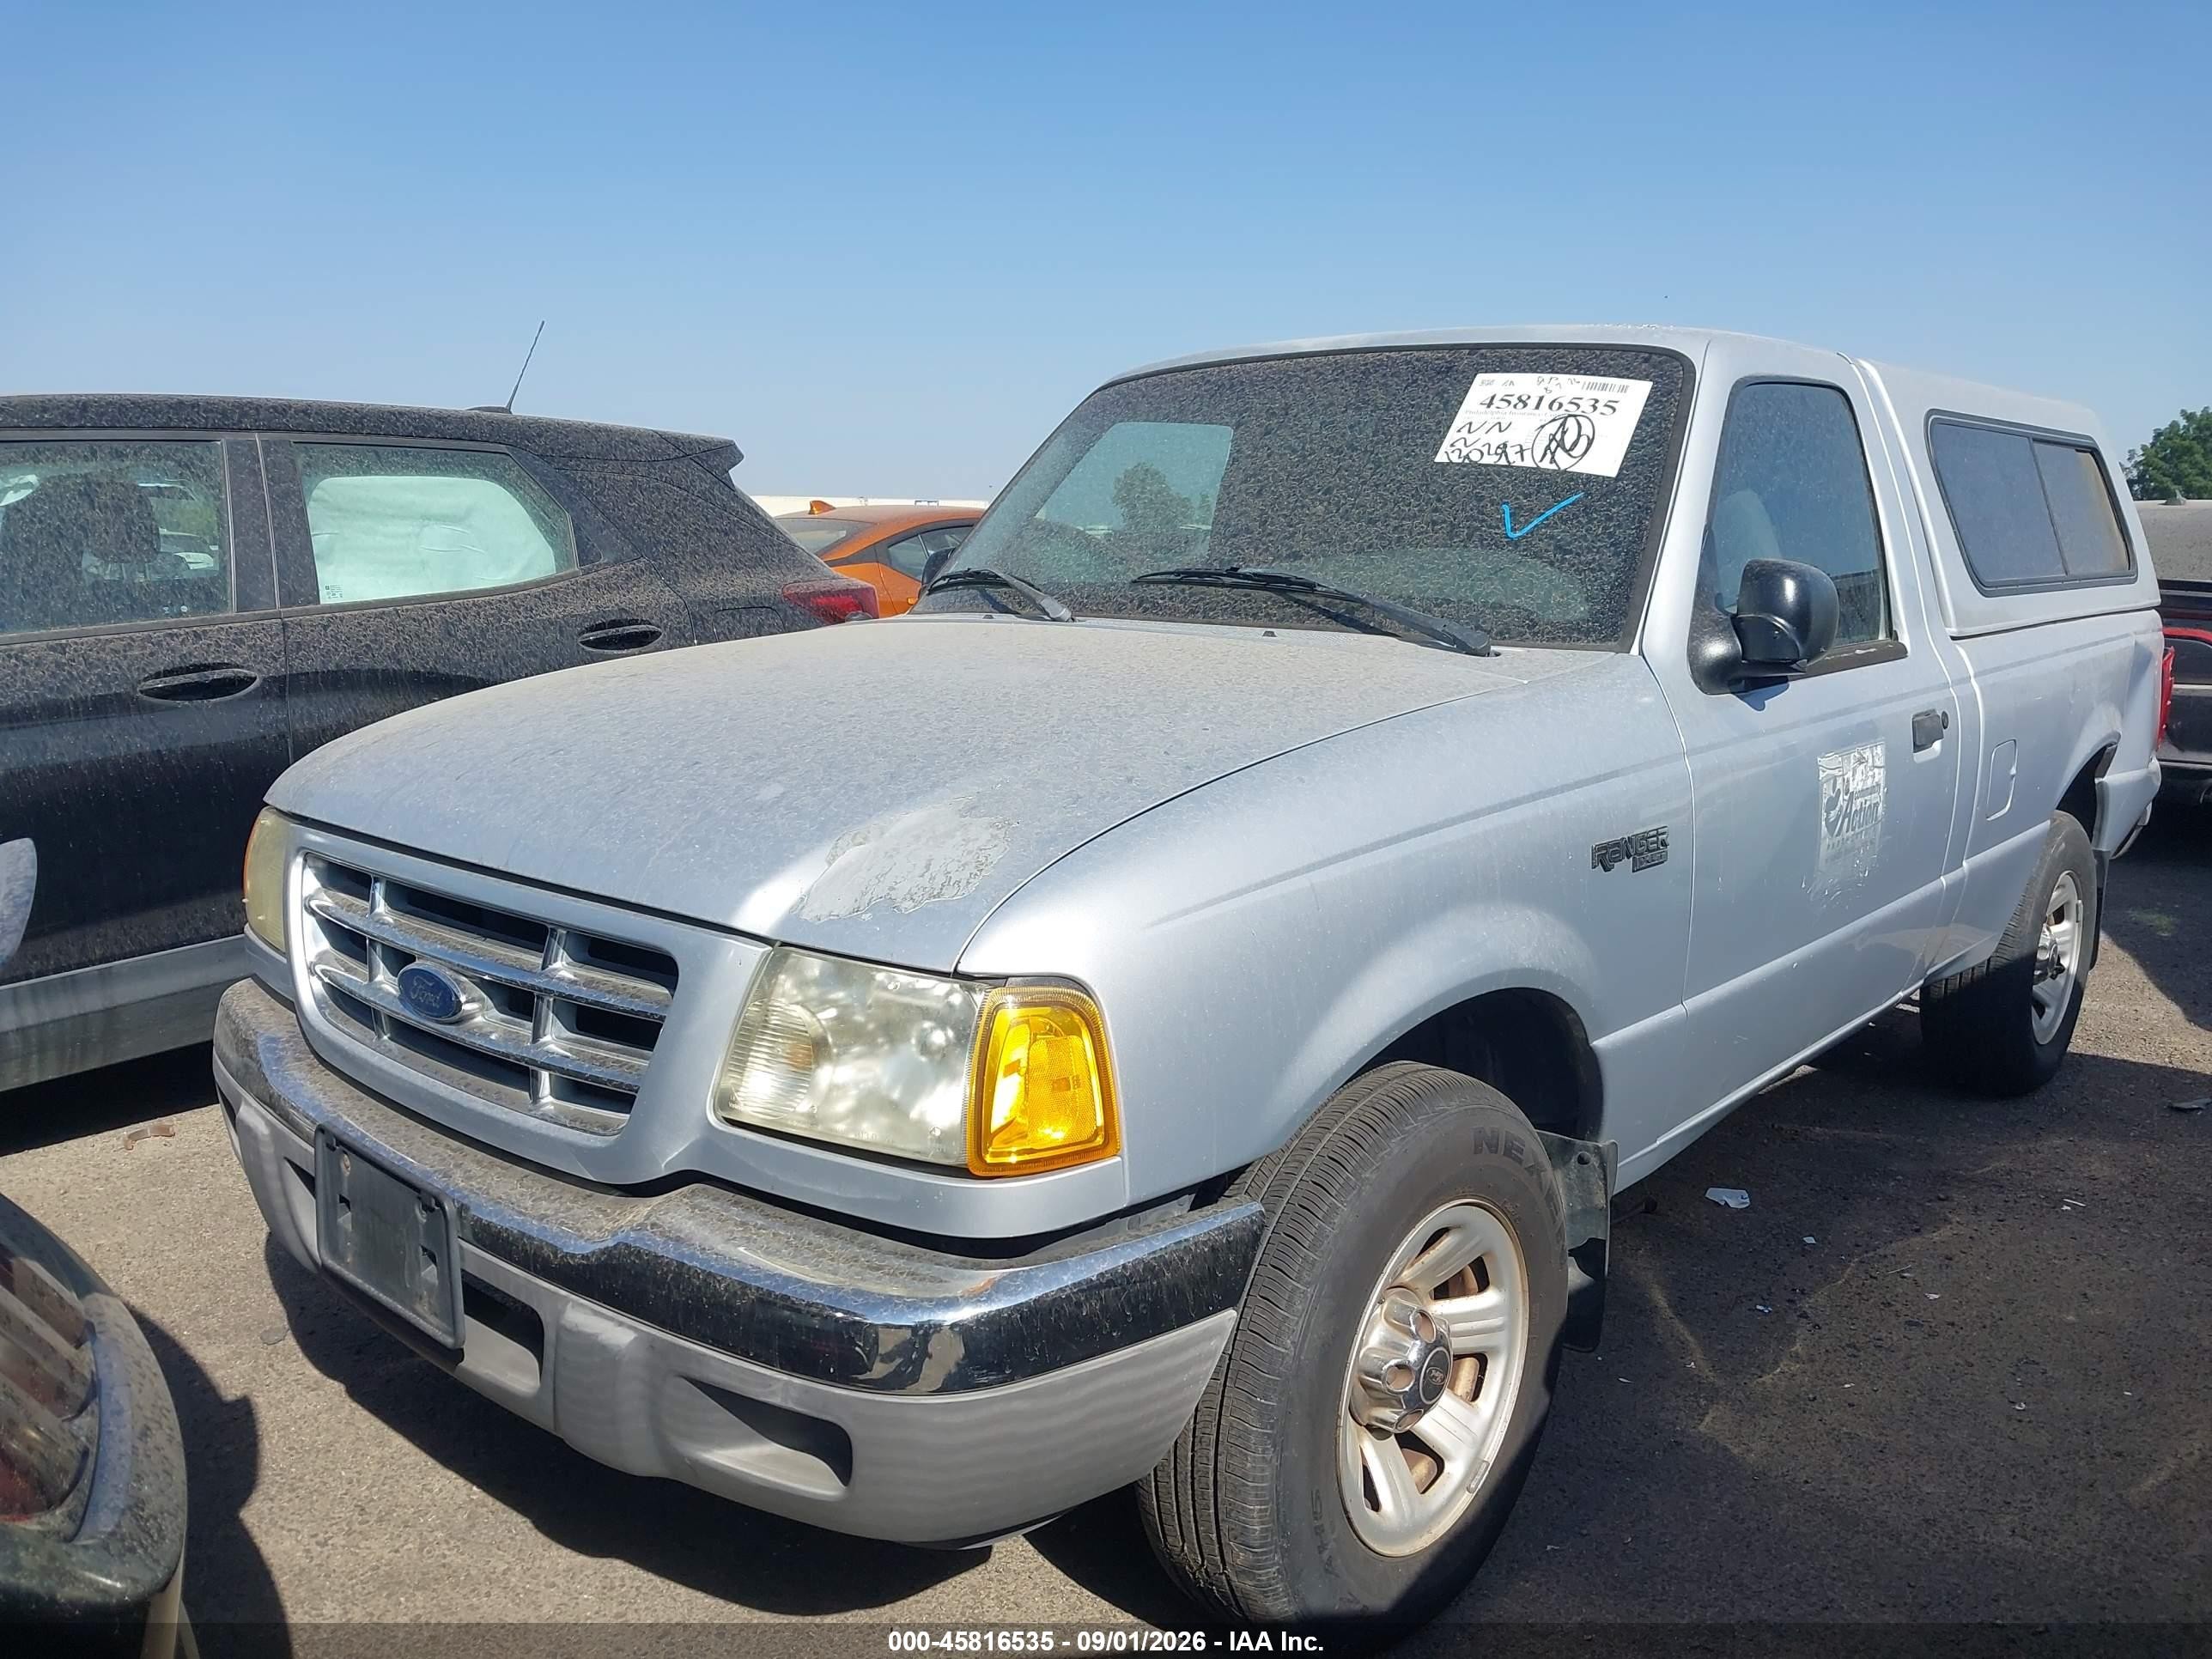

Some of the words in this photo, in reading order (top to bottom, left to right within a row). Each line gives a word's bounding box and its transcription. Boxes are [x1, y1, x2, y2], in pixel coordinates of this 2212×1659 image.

[1479, 392, 1620, 416] 45816535
[1591, 825, 1669, 872] RANGER
[410, 975, 443, 1009] Ford
